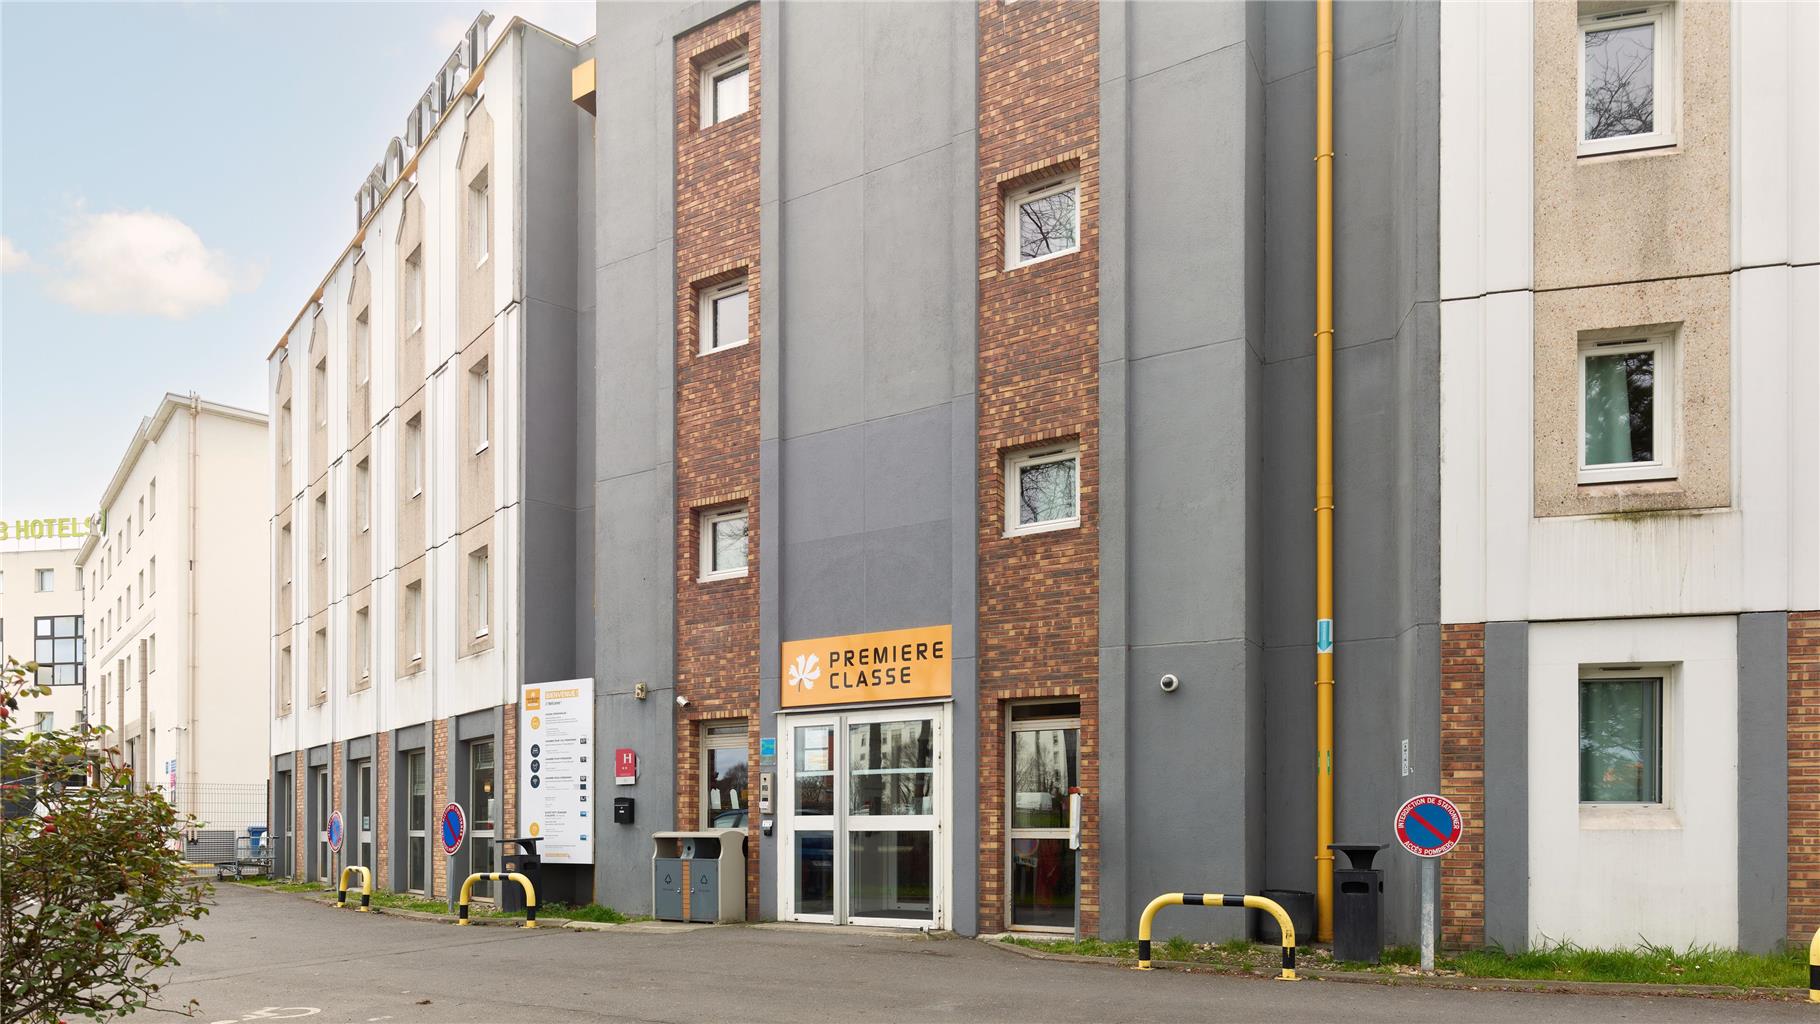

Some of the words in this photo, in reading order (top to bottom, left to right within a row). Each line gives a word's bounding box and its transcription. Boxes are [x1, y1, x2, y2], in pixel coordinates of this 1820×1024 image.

[829, 641, 944, 668] PREMIERE
[829, 666, 911, 689] CLASSE
[623, 753, 632, 764] H
[1398, 797, 1426, 829] INTERDICTION
[1437, 799, 1460, 830] STATIONNER
[1424, 840, 1454, 855] POMPIERS
